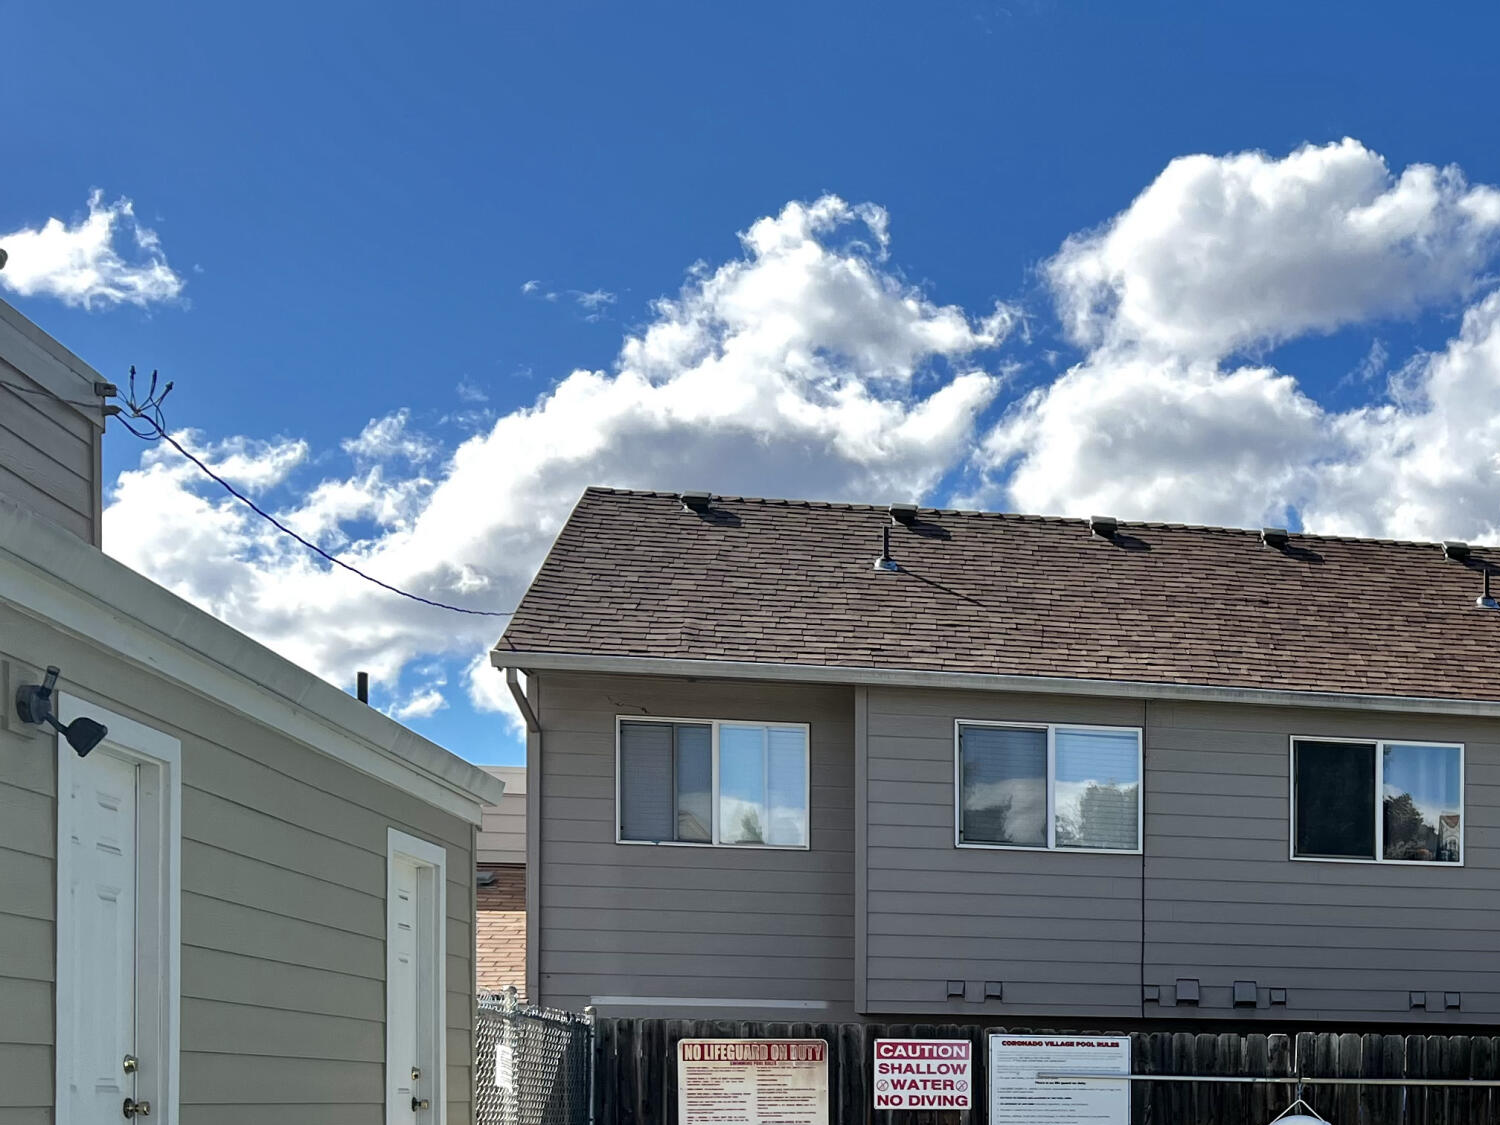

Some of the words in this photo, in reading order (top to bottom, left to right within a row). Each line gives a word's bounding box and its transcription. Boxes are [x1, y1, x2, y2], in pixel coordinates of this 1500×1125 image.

[684, 1044, 701, 1060] NO
[704, 1044, 768, 1060] LIFEGUARD
[771, 1044, 787, 1060] ON
[790, 1044, 822, 1060] DUTY
[880, 1045, 965, 1058] CAUTION
[878, 1063, 967, 1075] SHALLOW
[891, 1079, 954, 1090] WATER
[877, 1095, 903, 1106] NO
[909, 1095, 968, 1106] DIVING
